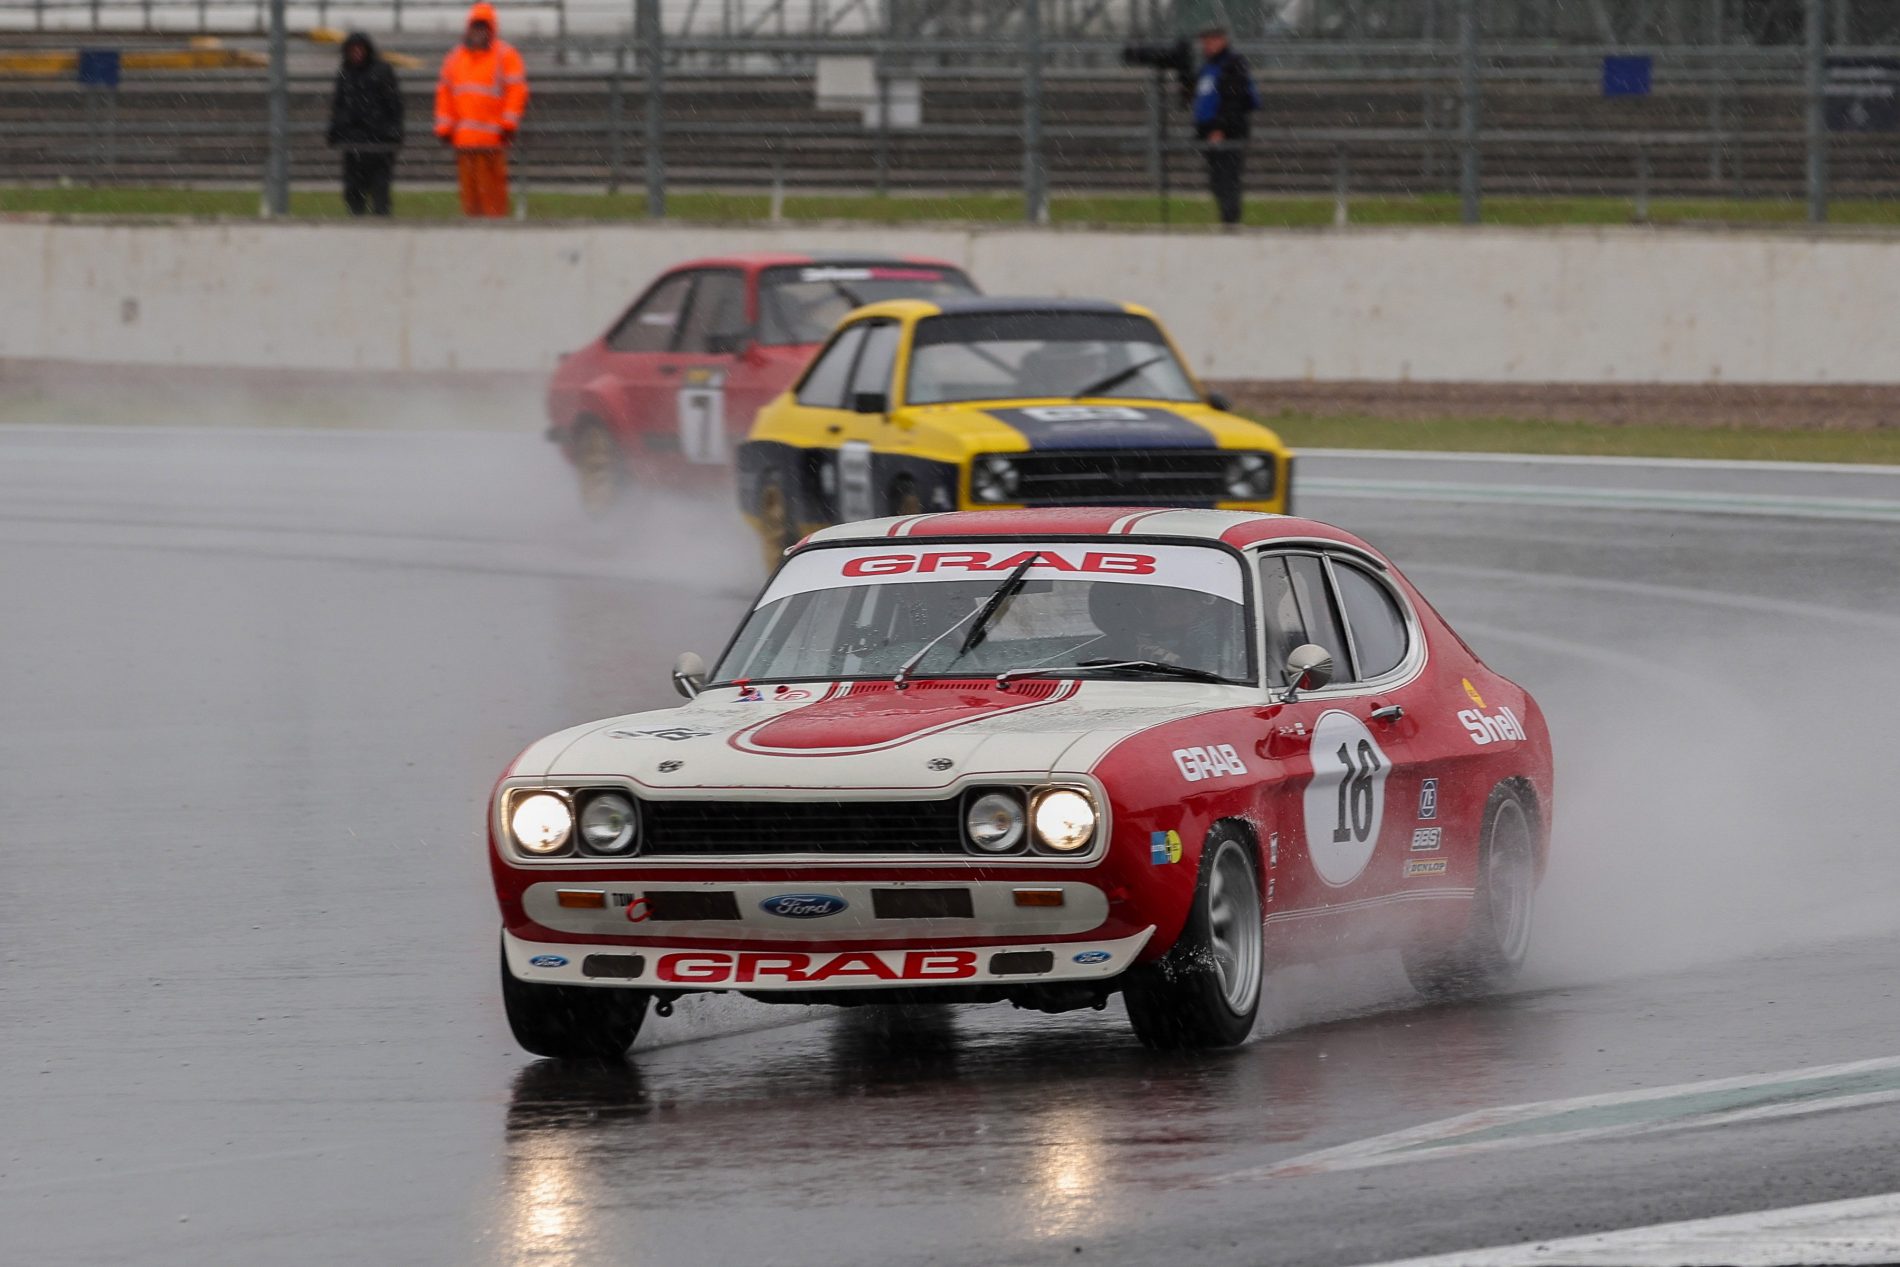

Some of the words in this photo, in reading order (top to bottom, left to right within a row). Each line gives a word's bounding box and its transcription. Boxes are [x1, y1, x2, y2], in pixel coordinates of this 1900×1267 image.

[842, 551, 1156, 577] GRAB
[1457, 706, 1527, 745] Shell
[1172, 744, 1248, 782] GRAB
[1413, 827, 1439, 847] BBS
[776, 897, 831, 914] Ford
[656, 951, 977, 983] GRAB
